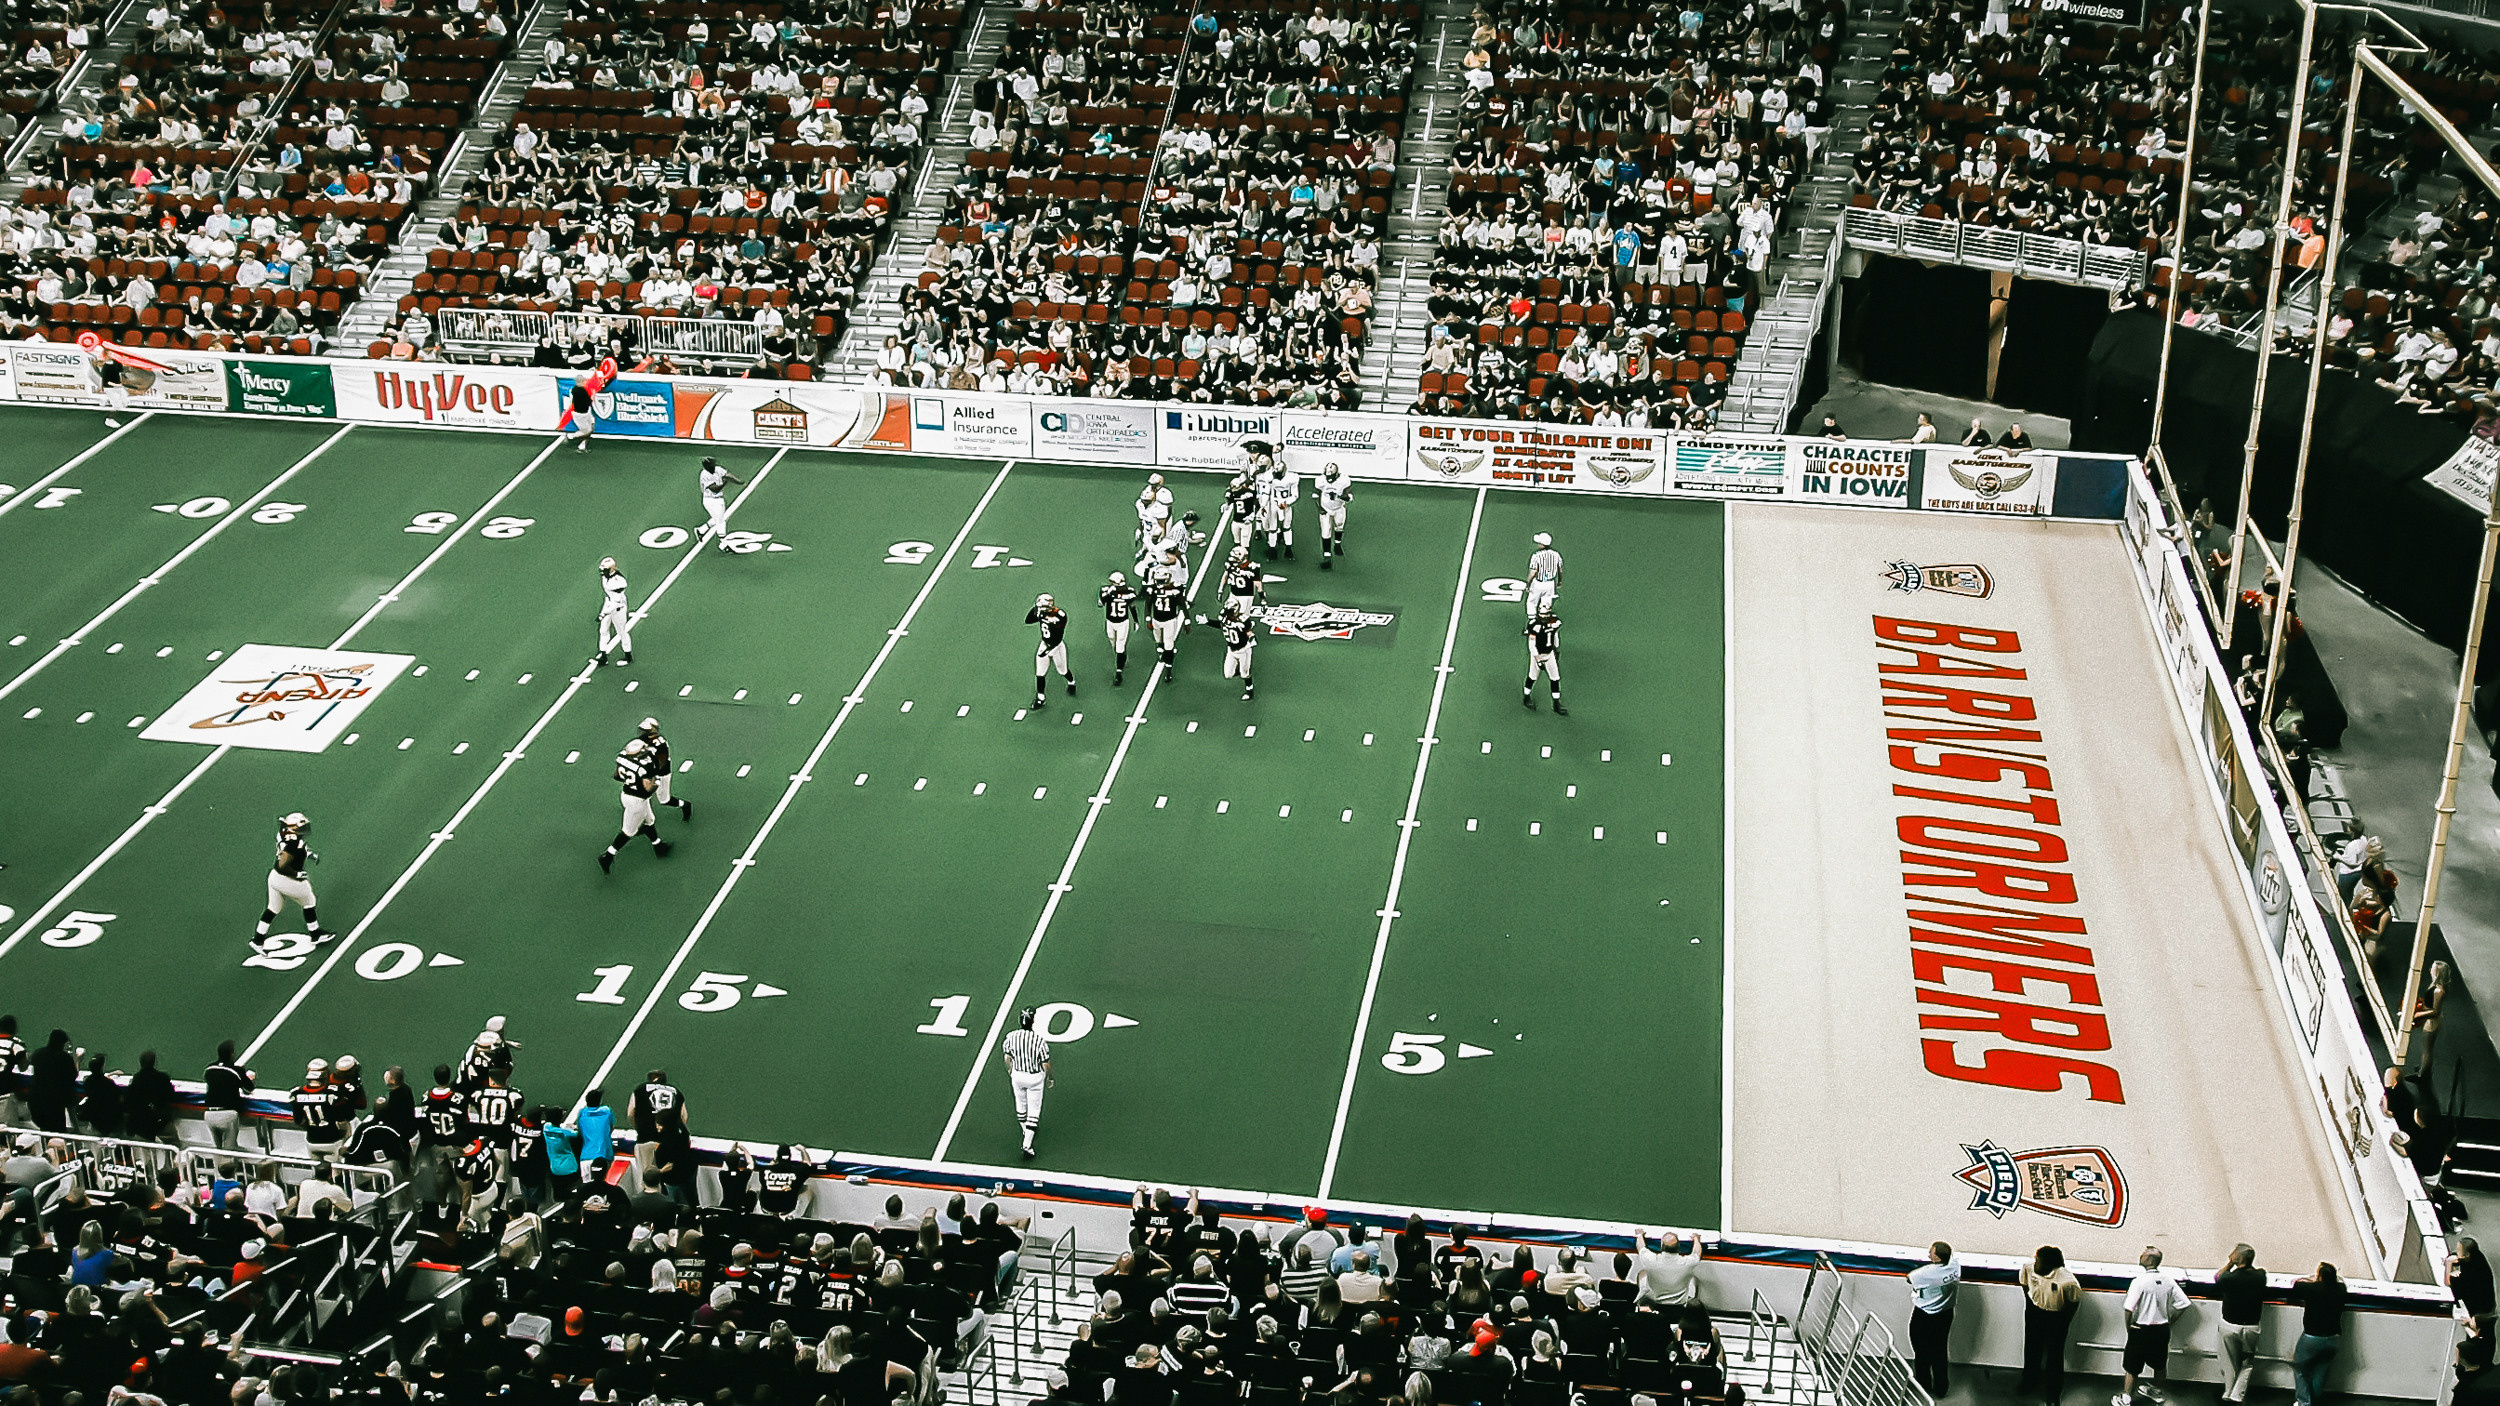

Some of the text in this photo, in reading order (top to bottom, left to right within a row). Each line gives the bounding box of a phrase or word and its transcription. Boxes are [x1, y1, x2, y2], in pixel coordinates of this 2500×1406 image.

[2069, 3, 2124, 20] wireless
[1670, 244, 1677, 258] 4
[16, 352, 81, 365] FASTSIGNS
[246, 374, 290, 396] Mercy
[953, 406, 994, 419] Allied
[953, 421, 1018, 435] Insurance
[1286, 426, 1374, 442] Accelerated
[1419, 426, 1456, 440] GET
[1460, 429, 1515, 443] YOUR
[1519, 431, 1612, 449] TAILGATE
[1677, 440, 1787, 452] COMPETITIVE
[1492, 458, 1510, 467] AT
[1828, 461, 1905, 477] COUNTS
[1549, 473, 1576, 484] LOT
[1802, 474, 1908, 498] IN IOWA
[1928, 499, 1940, 507] THE
[1904, 563, 1921, 590] FIELD
[1481, 578, 1527, 602] 5
[1110, 602, 1127, 617] 15
[1155, 599, 1171, 611] 41
[236, 678, 373, 704] ARENA
[1872, 614, 2126, 1105] BARNSTORMERS
[576, 964, 749, 1012] 1 5
[916, 995, 971, 1036] 1
[1381, 1031, 1446, 1075] 5
[303, 1105, 329, 1126] 11
[480, 1098, 507, 1124] 10
[430, 1112, 456, 1136] 50
[518, 1137, 533, 1157] 7
[764, 1170, 797, 1182] Iowa
[1989, 1153, 2014, 1205] FIELD
[1145, 1226, 1173, 1246] 77
[777, 1275, 797, 1306] 2
